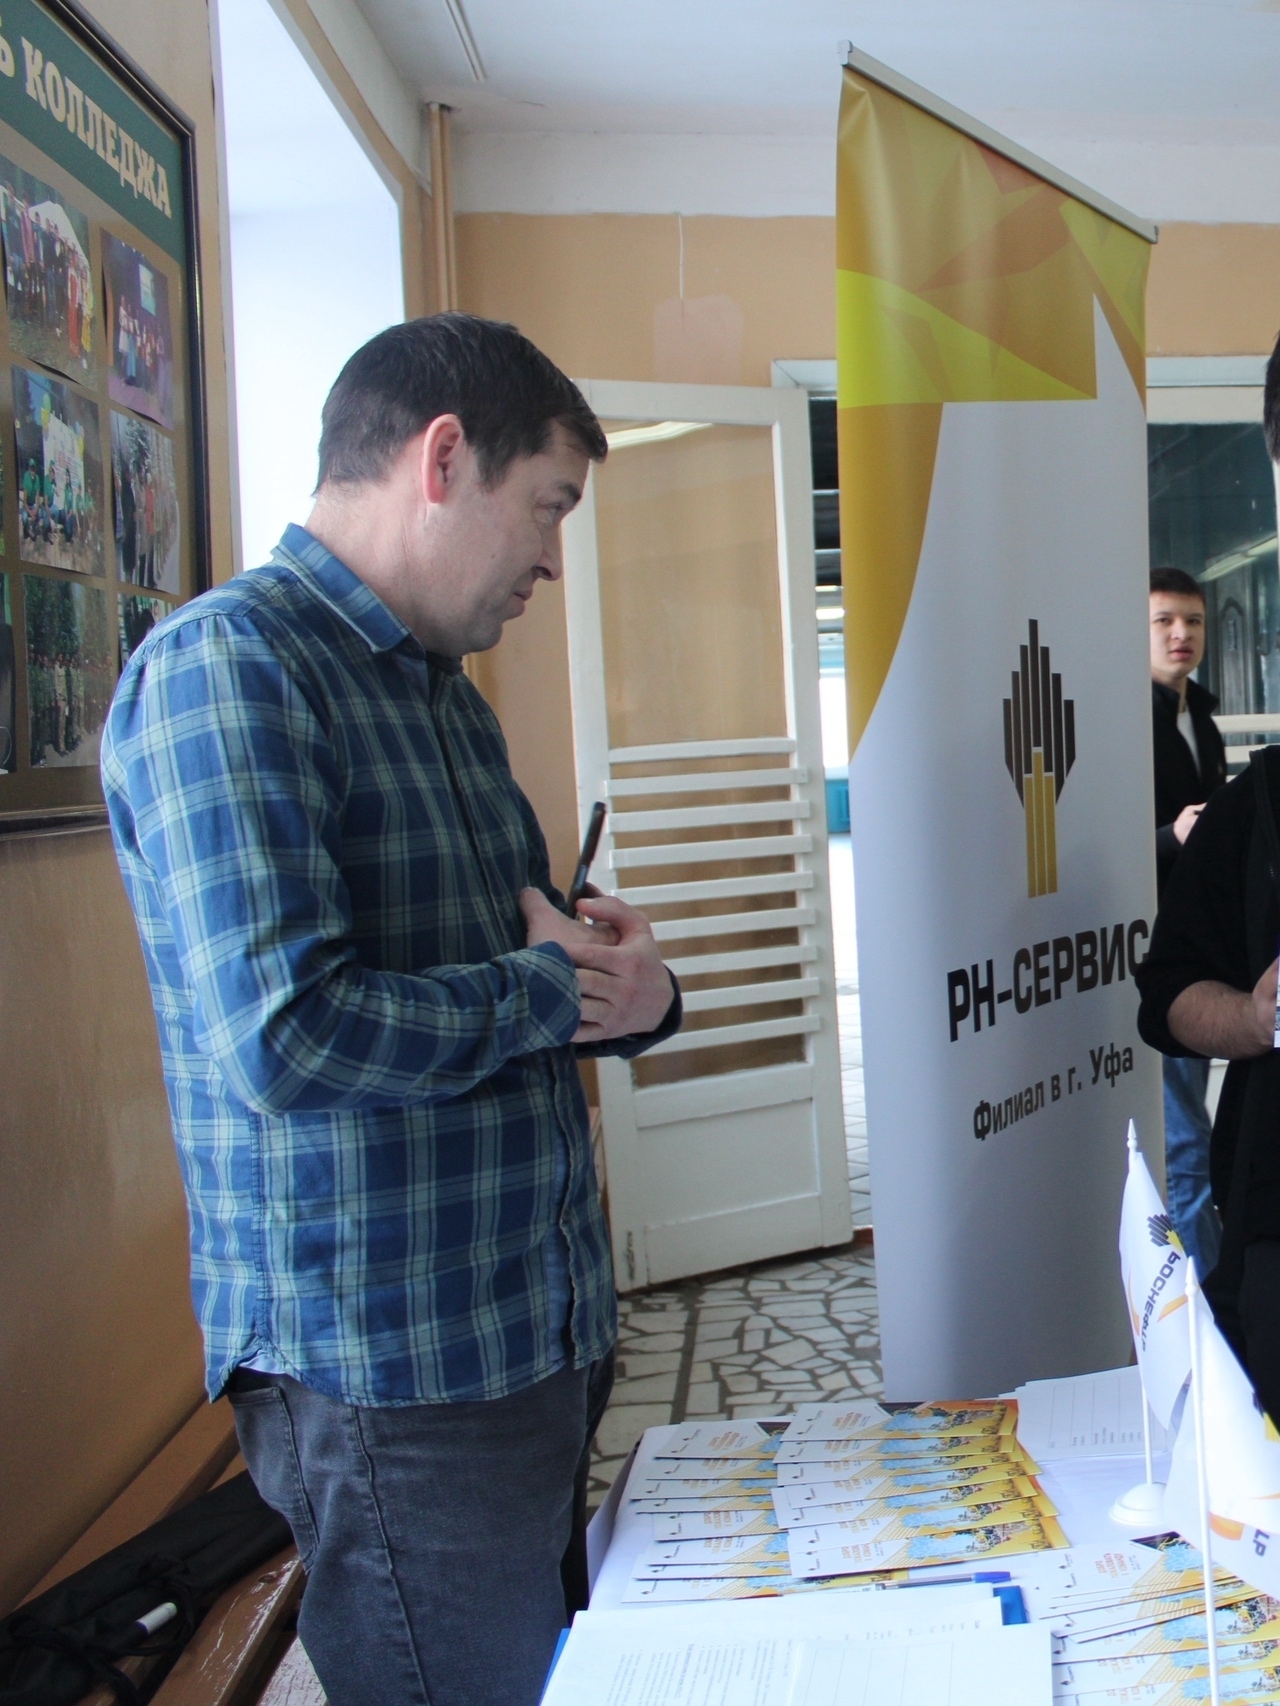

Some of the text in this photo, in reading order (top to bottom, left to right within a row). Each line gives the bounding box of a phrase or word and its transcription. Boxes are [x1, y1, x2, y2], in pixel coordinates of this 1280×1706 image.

[21, 36, 172, 219] КОЛЛЕДЖА
[947, 919, 1149, 1042] РН-СЕРВИС
[973, 1042, 1134, 1141] Филиал в г. Уфа
